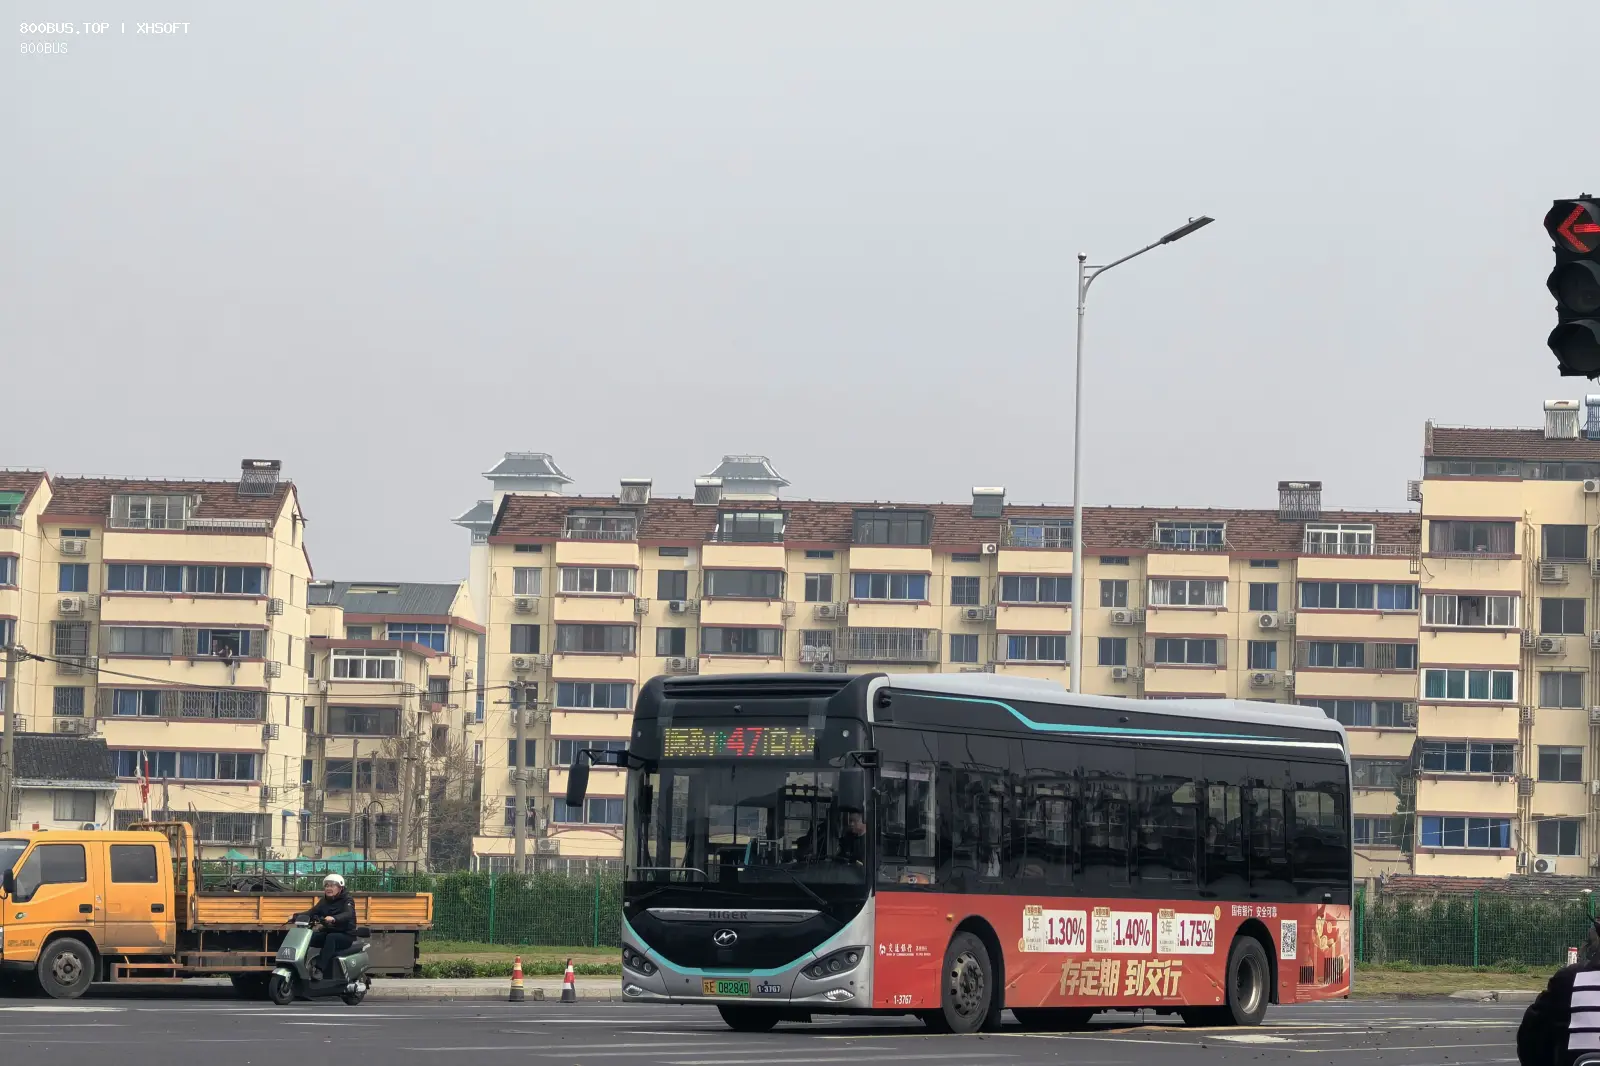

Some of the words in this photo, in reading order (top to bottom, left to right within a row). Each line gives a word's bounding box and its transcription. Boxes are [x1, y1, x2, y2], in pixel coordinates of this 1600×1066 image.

[726, 727, 763, 757] 47
[708, 911, 748, 919] HIGER
[1256, 906, 1278, 918] 安全可靠
[1027, 917, 1040, 932] 1年
[1048, 917, 1085, 945] 1.30%
[1096, 919, 1108, 933] 2年
[1161, 920, 1173, 935] 3年
[1115, 919, 1151, 946] 1.40%
[1180, 920, 1213, 946] 1.75%
[1060, 958, 1120, 996] 存定期
[1124, 959, 1182, 996] 到交行
[893, 995, 912, 1005] 1-3767
